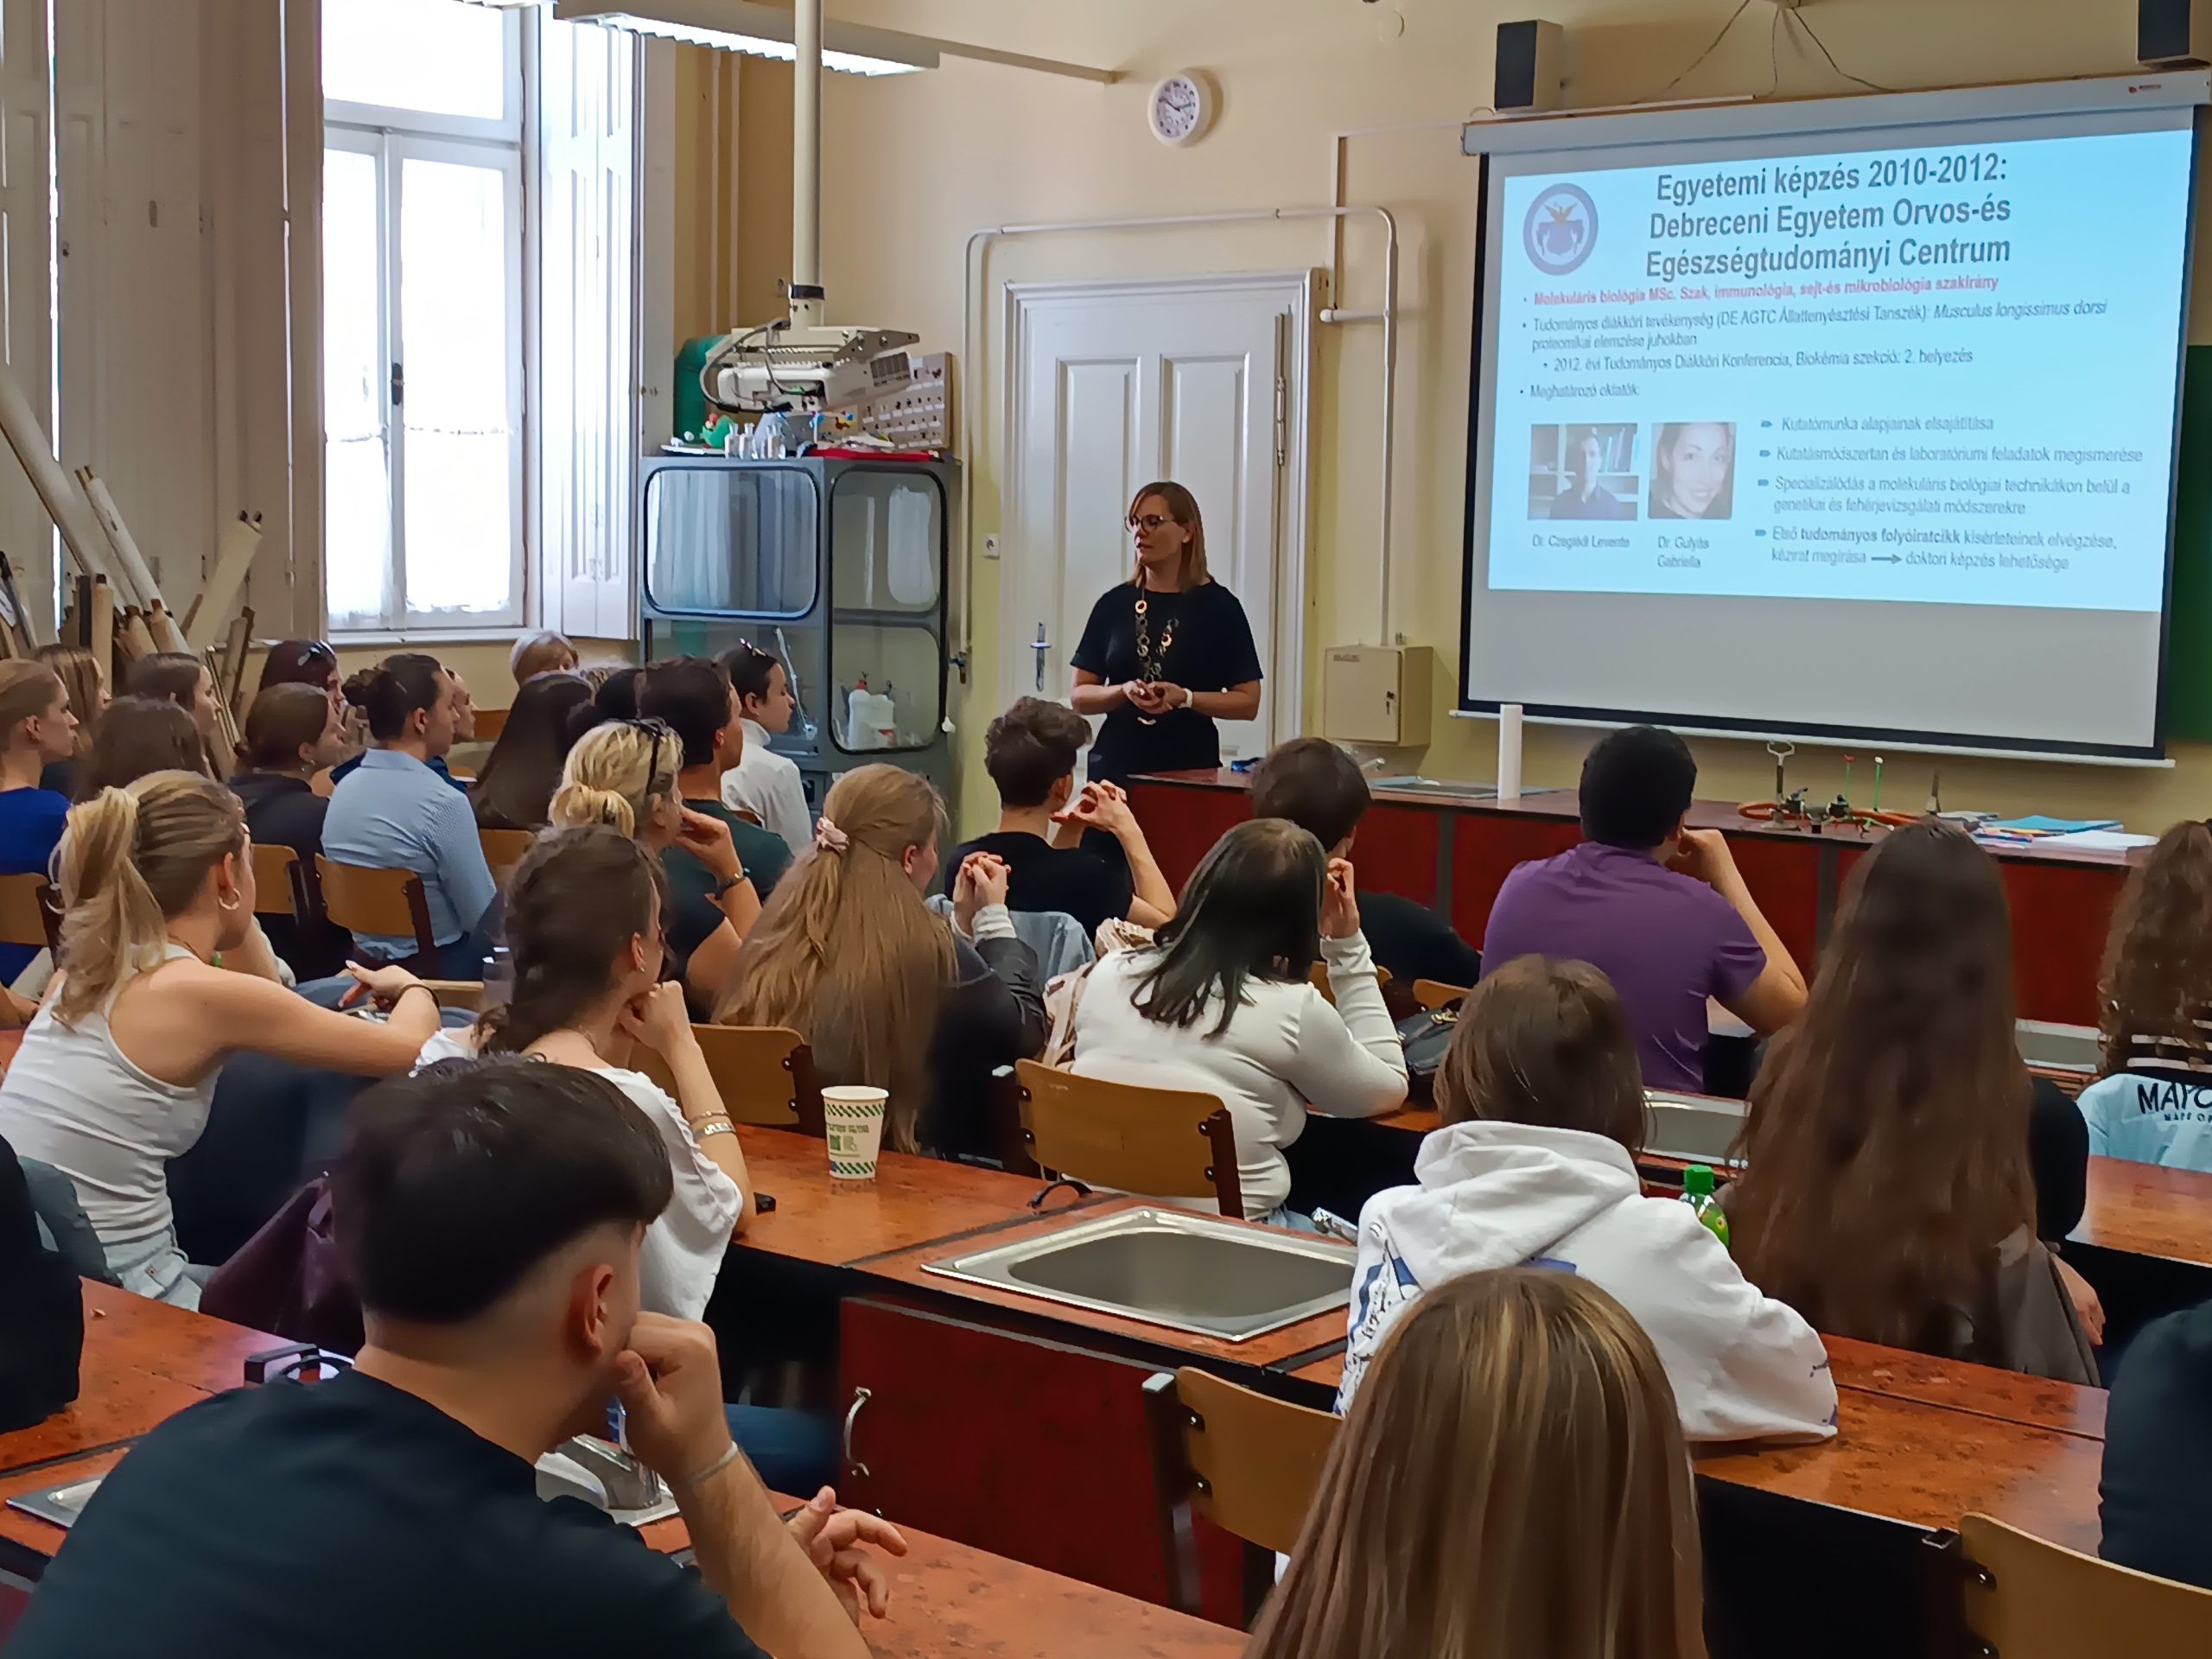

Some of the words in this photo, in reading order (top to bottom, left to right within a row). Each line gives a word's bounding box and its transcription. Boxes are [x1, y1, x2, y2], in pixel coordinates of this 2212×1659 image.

[1657, 168, 1766, 206] Egyetemi
[1774, 162, 1860, 198] képzés
[1868, 153, 2006, 188] 2010-2012:
[1650, 207, 1768, 238] Debreceni
[1777, 205, 1884, 238] Egyetem
[1893, 193, 2011, 226] Orvos-és
[1647, 240, 1890, 283] Egészségtudományi
[1899, 238, 2011, 266] Centrum
[1845, 276, 1931, 295] mikrobiológia
[1534, 316, 1599, 334] Tudományos
[2074, 298, 2107, 316] dorsi
[1604, 355, 1671, 373] Tudományos
[1891, 446, 1906, 461] és
[1868, 480, 1876, 491] a
[2121, 482, 2131, 494] a
[1828, 498, 1843, 512] és
[1801, 526, 1877, 545] tudományos
[1950, 552, 1995, 570] képzés
